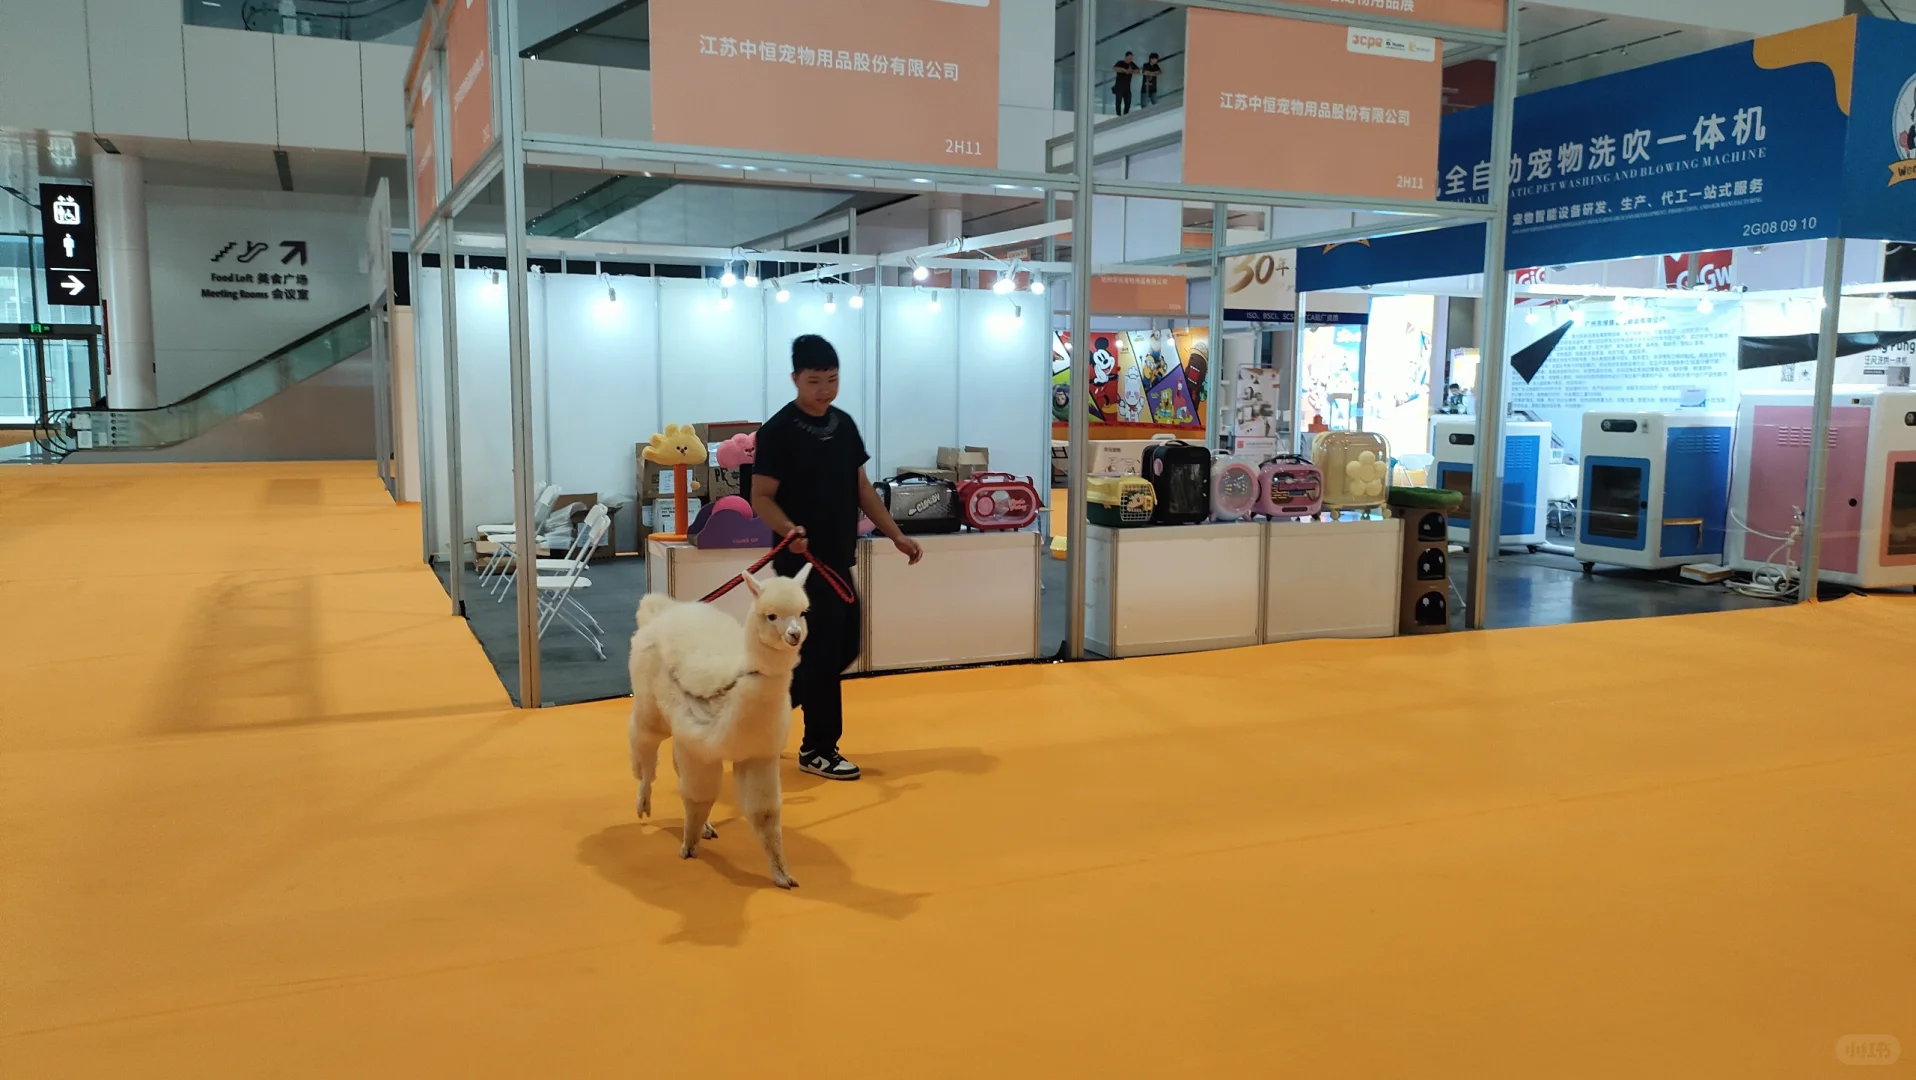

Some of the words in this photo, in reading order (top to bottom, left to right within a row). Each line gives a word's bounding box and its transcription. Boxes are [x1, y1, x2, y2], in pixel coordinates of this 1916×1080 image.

[699, 35, 960, 81] 江苏中恒宠物用品股份有限公司
[1220, 92, 1410, 126] 江苏中恒宠物用品股份有限公司
[945, 139, 982, 156] 2H11
[1536, 182, 1556, 194] PET
[1559, 172, 1611, 190] WASHING
[1615, 169, 1638, 182] AND
[1640, 159, 1699, 177] BLOWING
[1702, 147, 1767, 168] MACHINE
[1396, 175, 1424, 189] 2H11
[1742, 221, 1778, 237] 2G08
[1780, 219, 1797, 233] 09
[1800, 216, 1817, 230] 10
[211, 273, 234, 282] Food
[236, 273, 254, 283] Loft
[257, 272, 309, 285] 美食广场
[201, 289, 239, 301] Meeting
[240, 290, 269, 299] Rooms
[271, 288, 309, 301] 会议室
